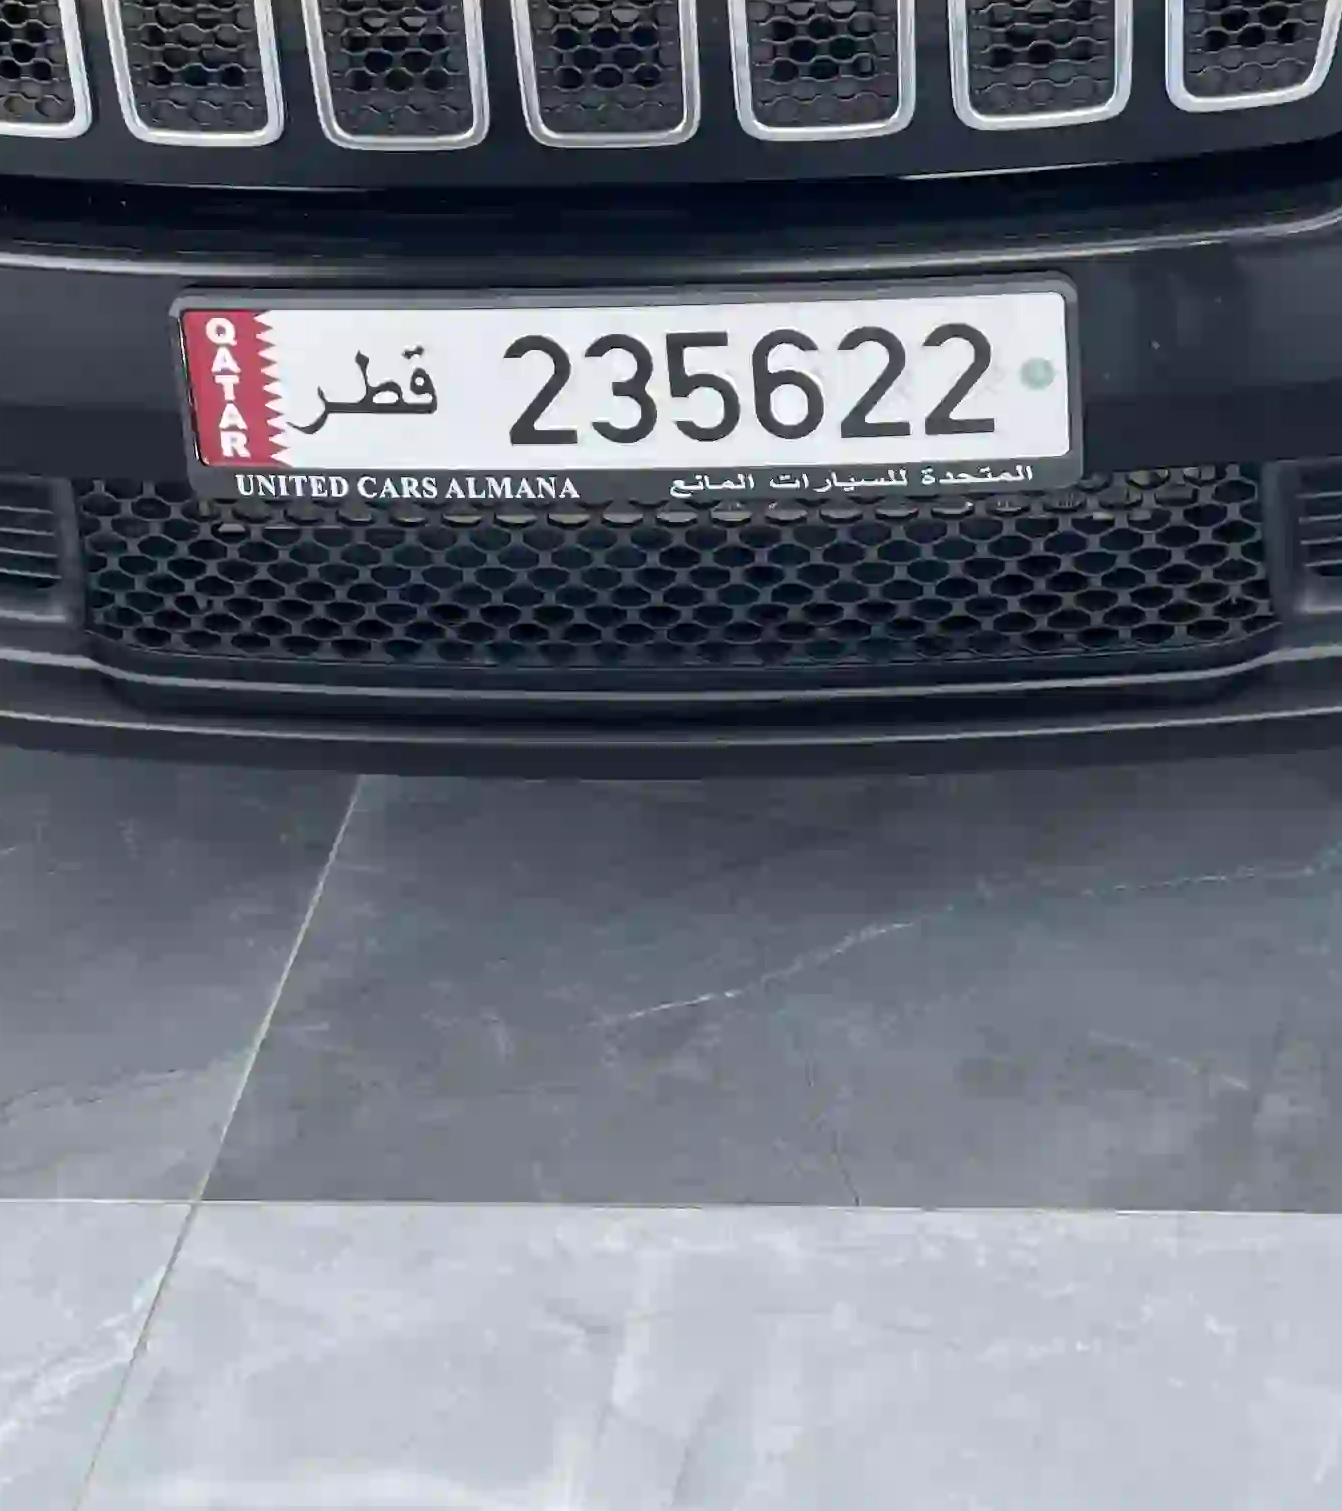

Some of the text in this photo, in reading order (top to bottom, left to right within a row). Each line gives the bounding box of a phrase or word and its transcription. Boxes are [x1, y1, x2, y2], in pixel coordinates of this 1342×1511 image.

[205, 316, 251, 459] QATAR
[286, 344, 438, 435] قطر
[503, 322, 996, 447] 235622
[235, 474, 581, 499] UNITED CARS ALMANA
[669, 464, 1034, 498] المتحدة للسيارات المانع
